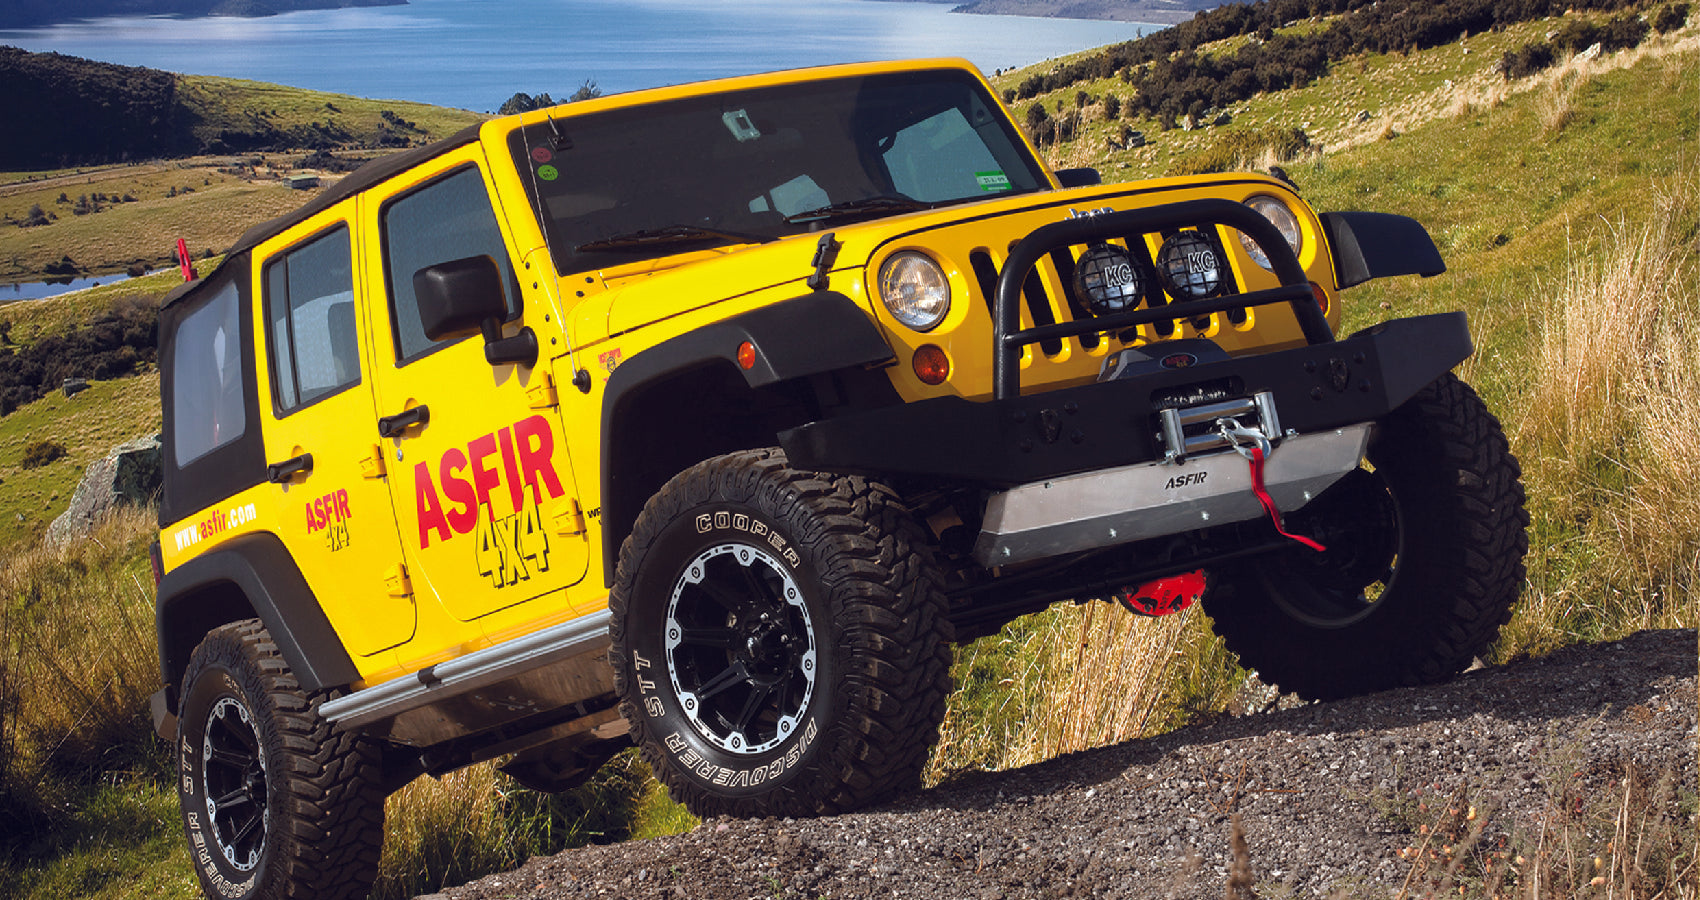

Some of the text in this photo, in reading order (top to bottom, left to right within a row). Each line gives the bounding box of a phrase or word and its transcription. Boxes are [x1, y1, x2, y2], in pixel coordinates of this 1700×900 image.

[1104, 263, 1133, 288] KC
[1188, 250, 1216, 274] KC
[413, 414, 566, 551] ASFIR
[1165, 471, 1208, 490] ASFIR
[174, 502, 257, 552] www.asfir.com
[305, 488, 353, 535] ASFIR
[696, 511, 801, 569] COOPER
[633, 650, 665, 718] STT
[181, 735, 195, 796] STT
[665, 717, 819, 787] DISCOVERER
